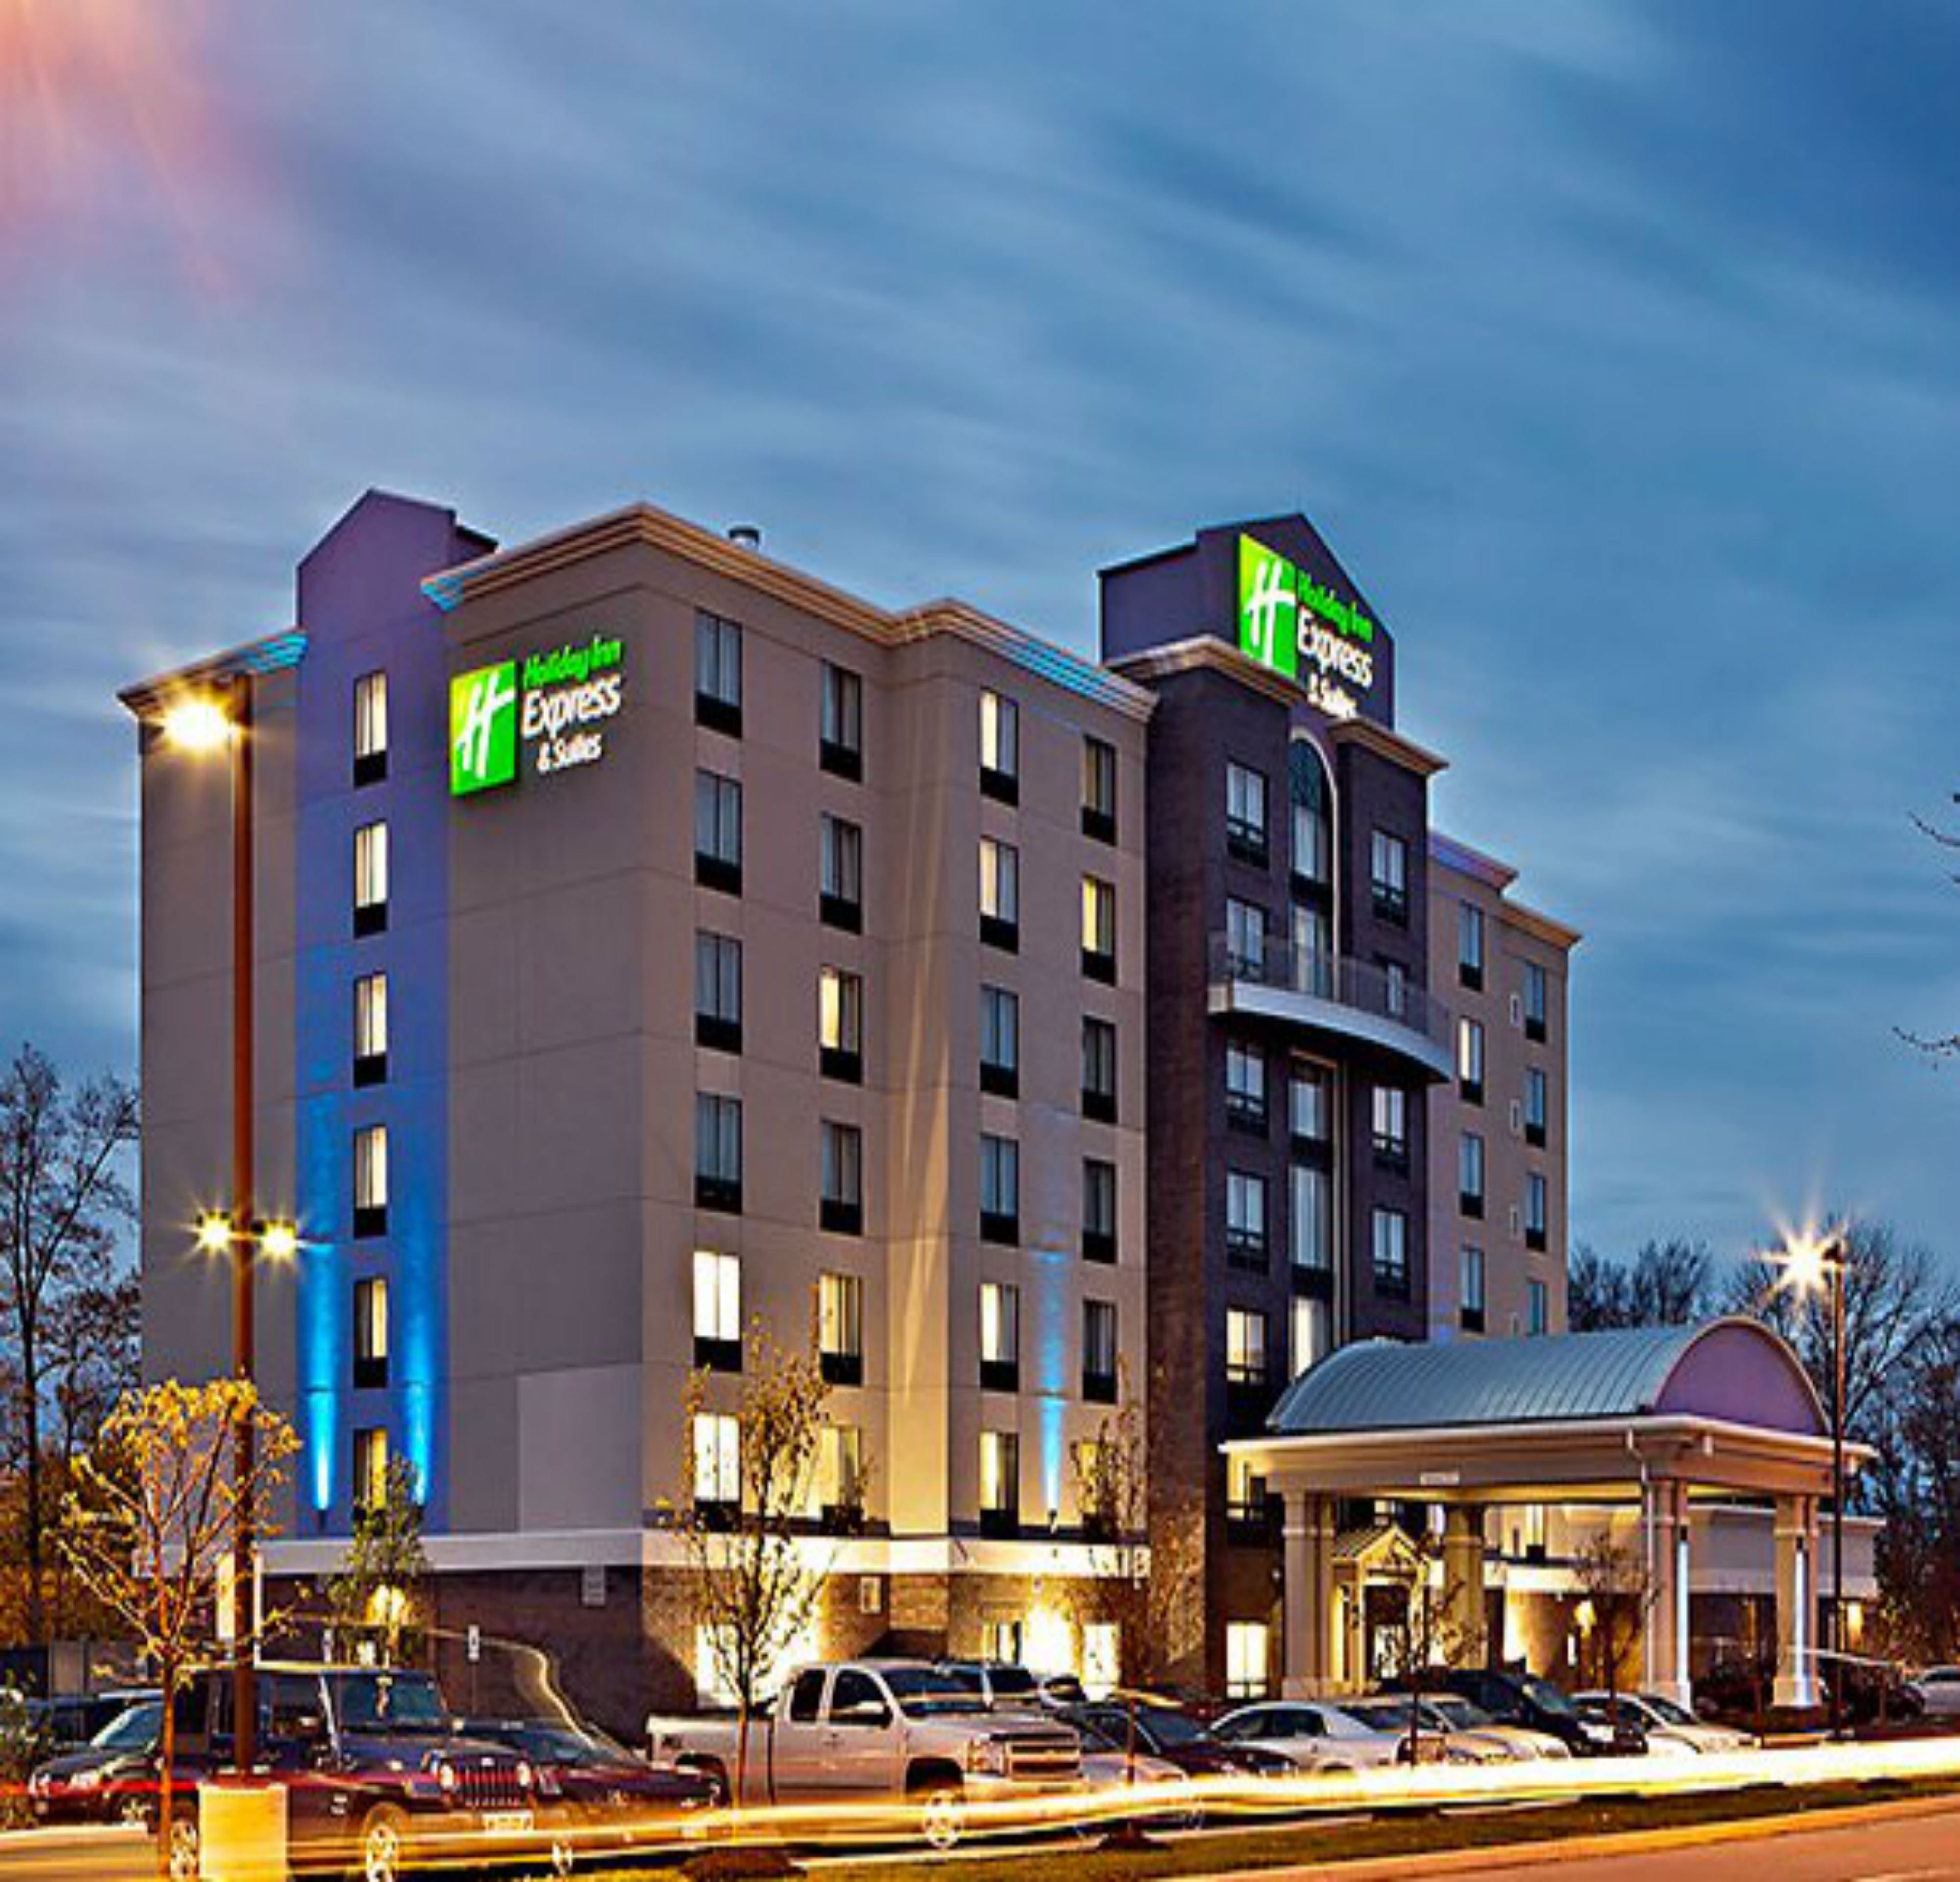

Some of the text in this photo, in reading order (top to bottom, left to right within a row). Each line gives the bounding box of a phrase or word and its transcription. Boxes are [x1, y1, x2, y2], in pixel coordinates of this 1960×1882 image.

[1298, 569, 1348, 635] Holiday
[523, 635, 621, 689] Holiday Inn
[1298, 604, 1372, 688] Express
[521, 673, 621, 738] Express
[551, 733, 601, 768] Suites
